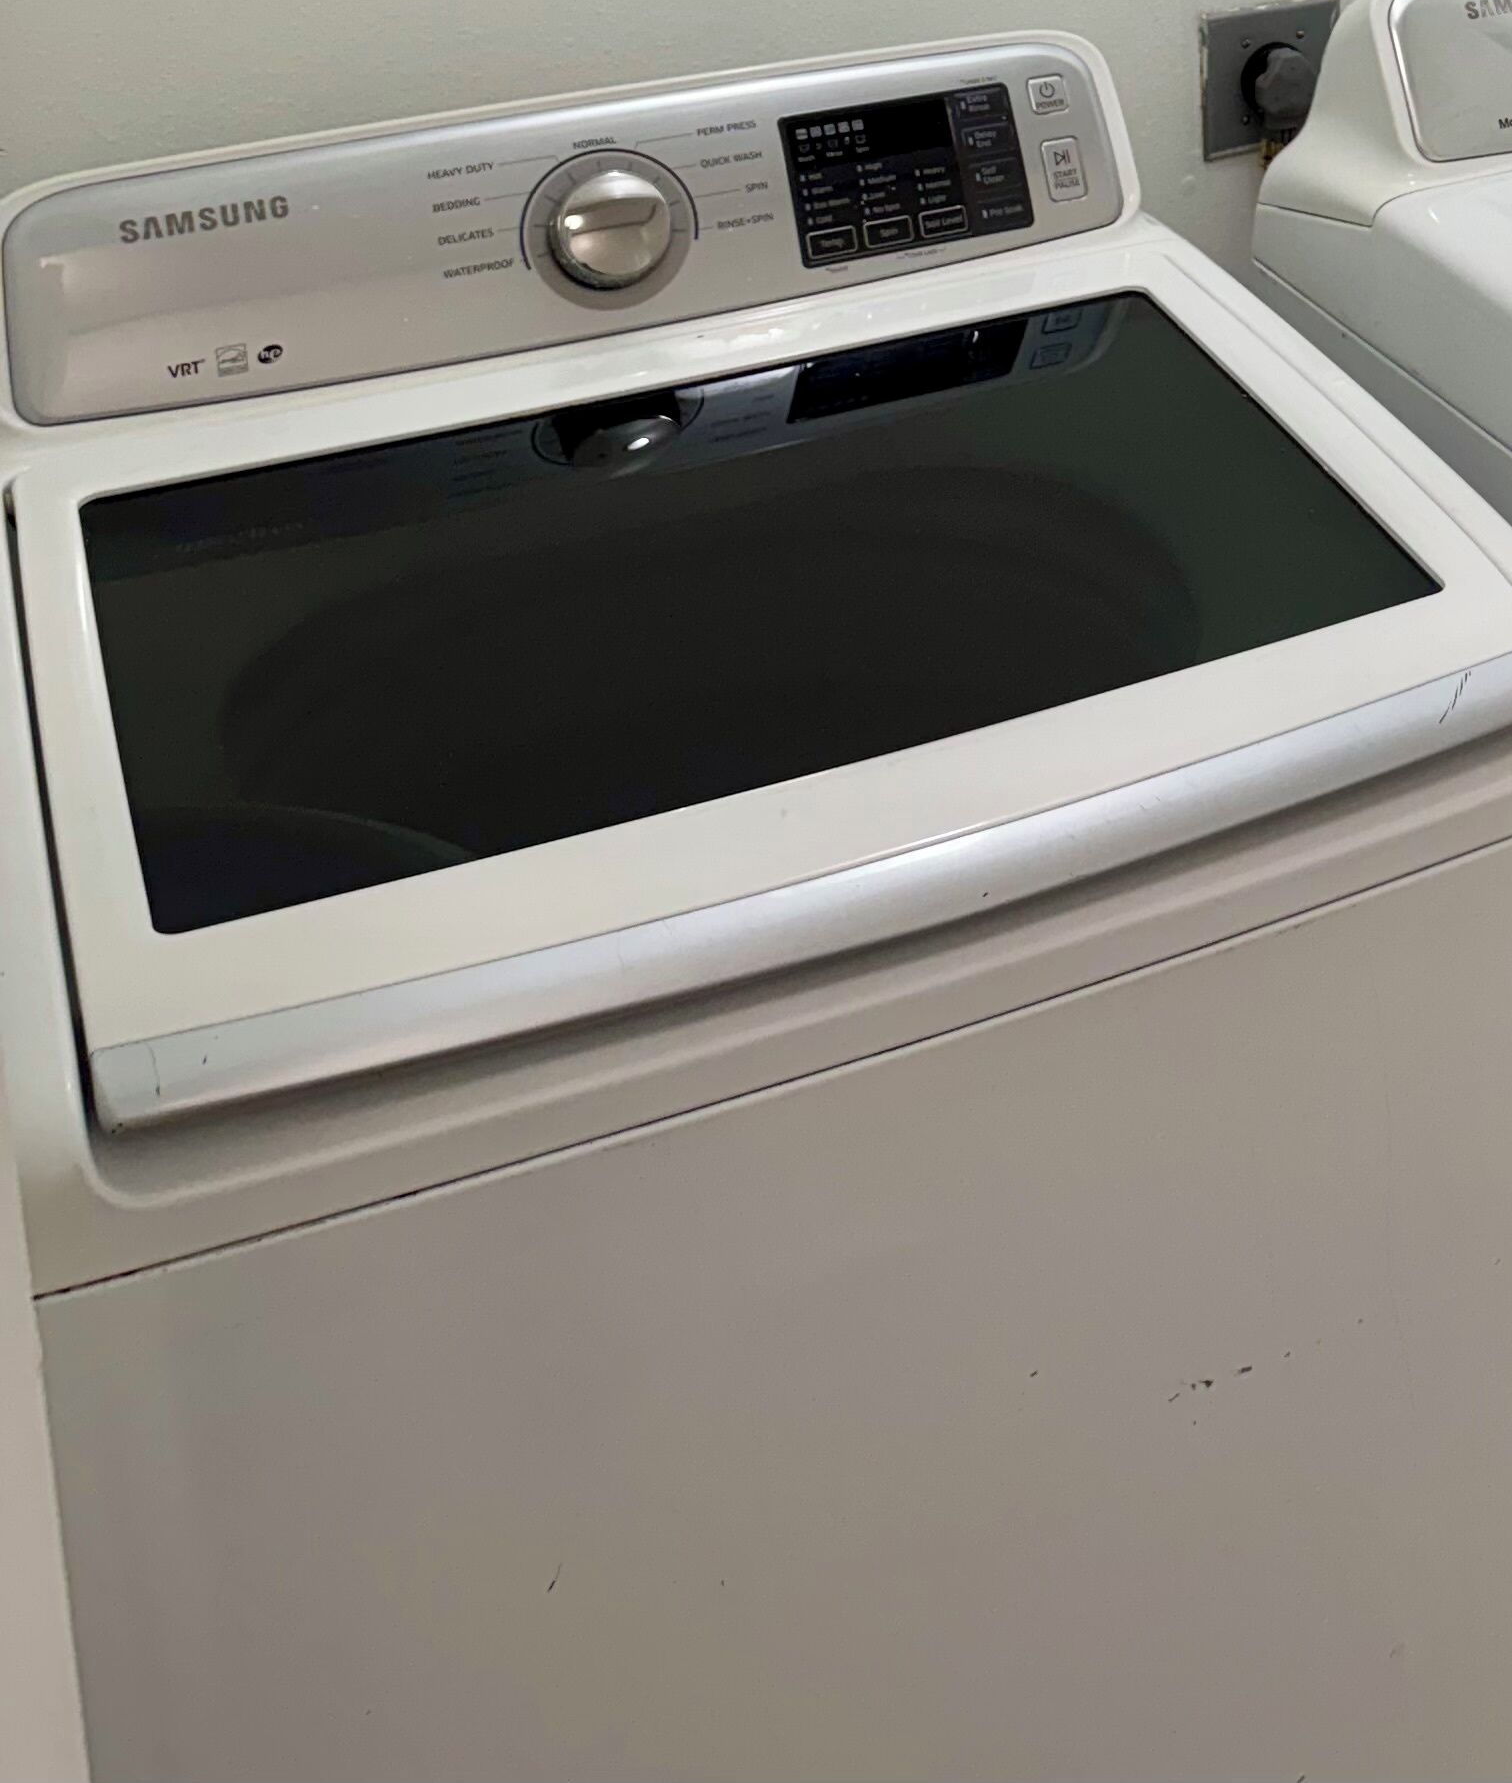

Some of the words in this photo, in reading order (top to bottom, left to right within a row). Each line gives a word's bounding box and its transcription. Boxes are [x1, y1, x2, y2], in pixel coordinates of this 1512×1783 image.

[696, 124, 724, 137] PERM
[727, 120, 756, 132] PRESS
[573, 136, 616, 150] NORMAL
[700, 156, 731, 169] QUICK
[734, 151, 762, 163] WASH
[427, 166, 462, 180] HEAVY
[466, 162, 494, 174] DUTY
[1053, 168, 1078, 178] START
[745, 182, 768, 194] SPIN
[432, 196, 481, 213] BEDDING
[119, 196, 290, 244] SAMSUNG
[438, 226, 495, 246] DELICATES
[443, 258, 514, 279] WATERPROOF
[167, 360, 202, 379] VRT
